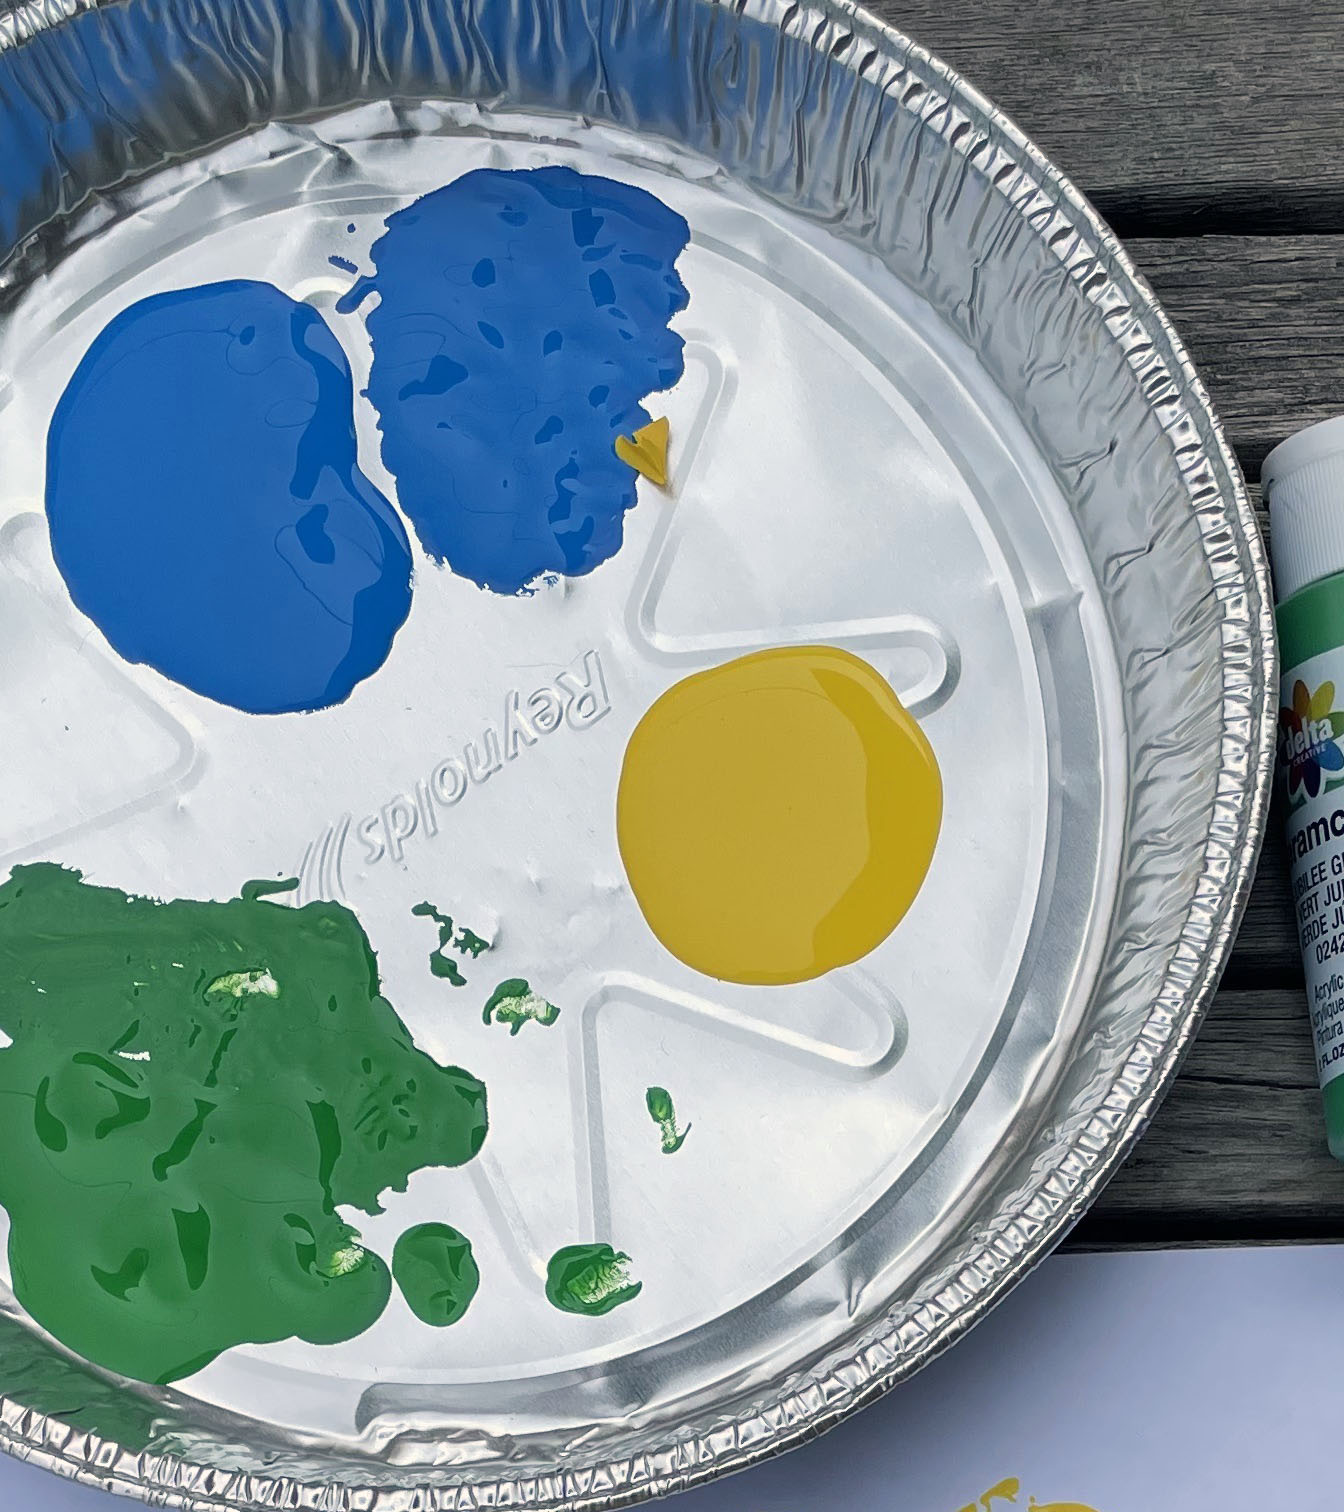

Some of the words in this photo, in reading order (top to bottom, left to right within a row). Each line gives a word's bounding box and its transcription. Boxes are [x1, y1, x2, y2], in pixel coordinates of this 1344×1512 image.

[356, 649, 612, 864] Reynolds
[1286, 716, 1334, 760] delta
[1315, 974, 1344, 1003] Acrylic
